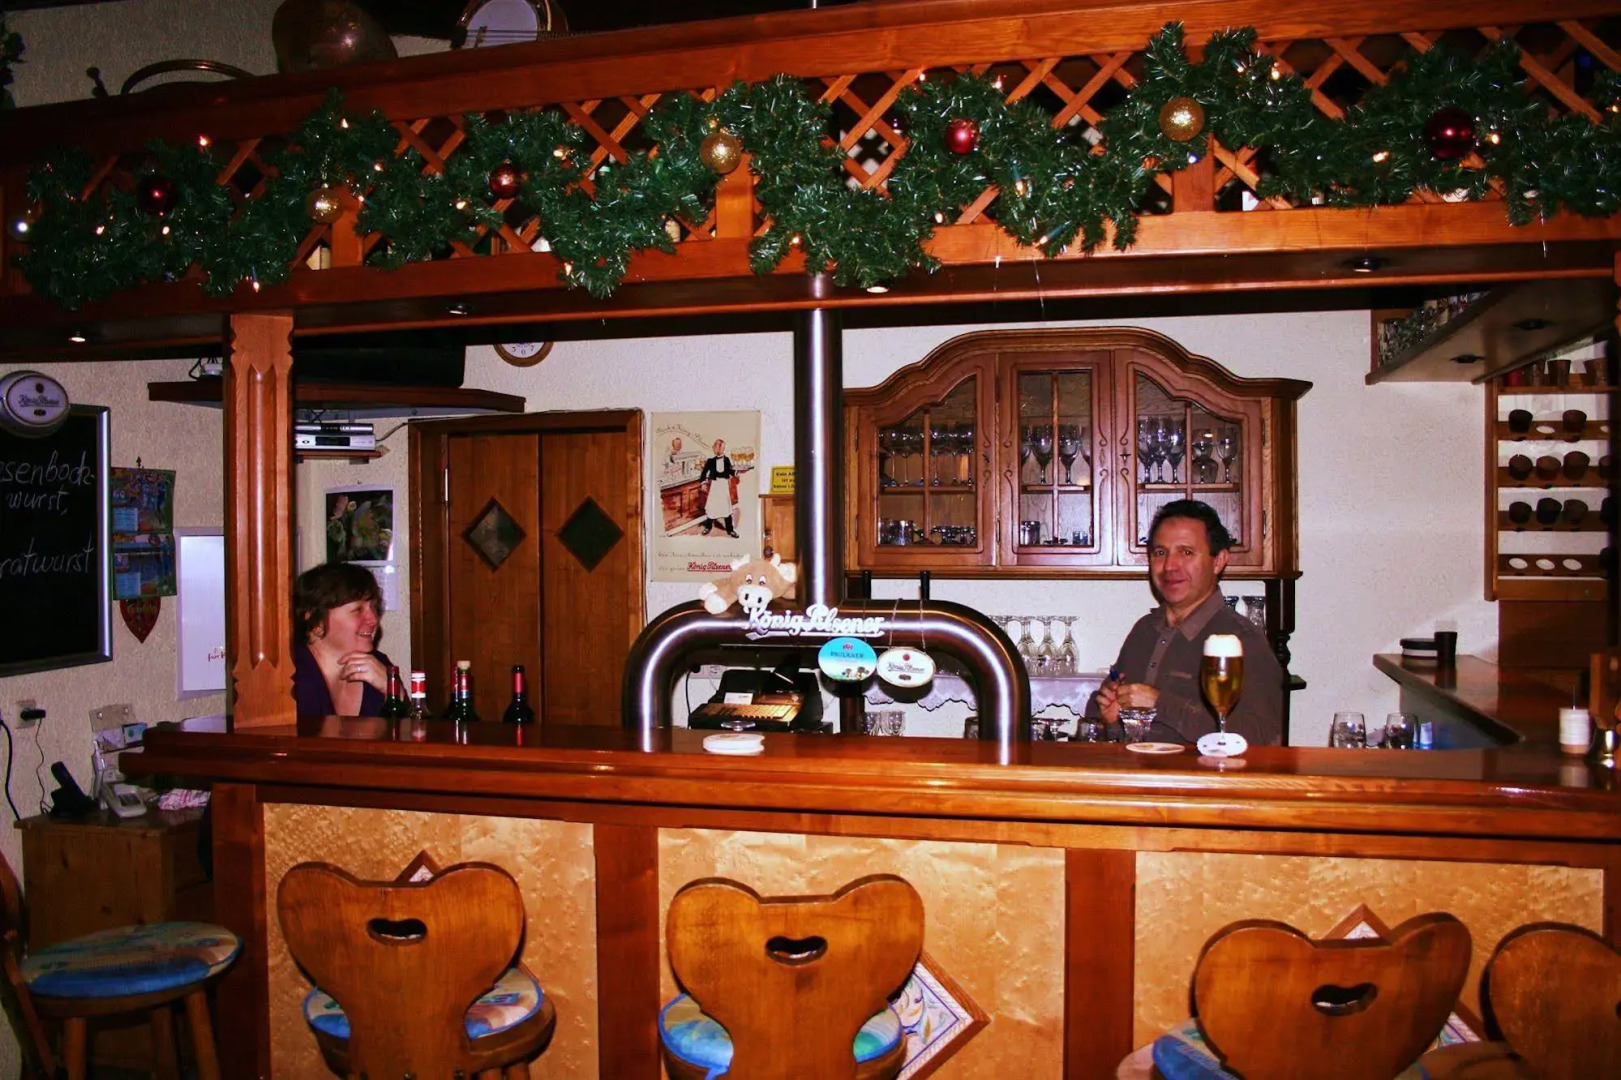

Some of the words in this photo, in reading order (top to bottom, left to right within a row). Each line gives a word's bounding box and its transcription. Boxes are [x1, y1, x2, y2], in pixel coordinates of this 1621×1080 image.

[688, 561, 708, 572] König
[745, 608, 804, 636] König
[805, 603, 885, 634] Pilsener
